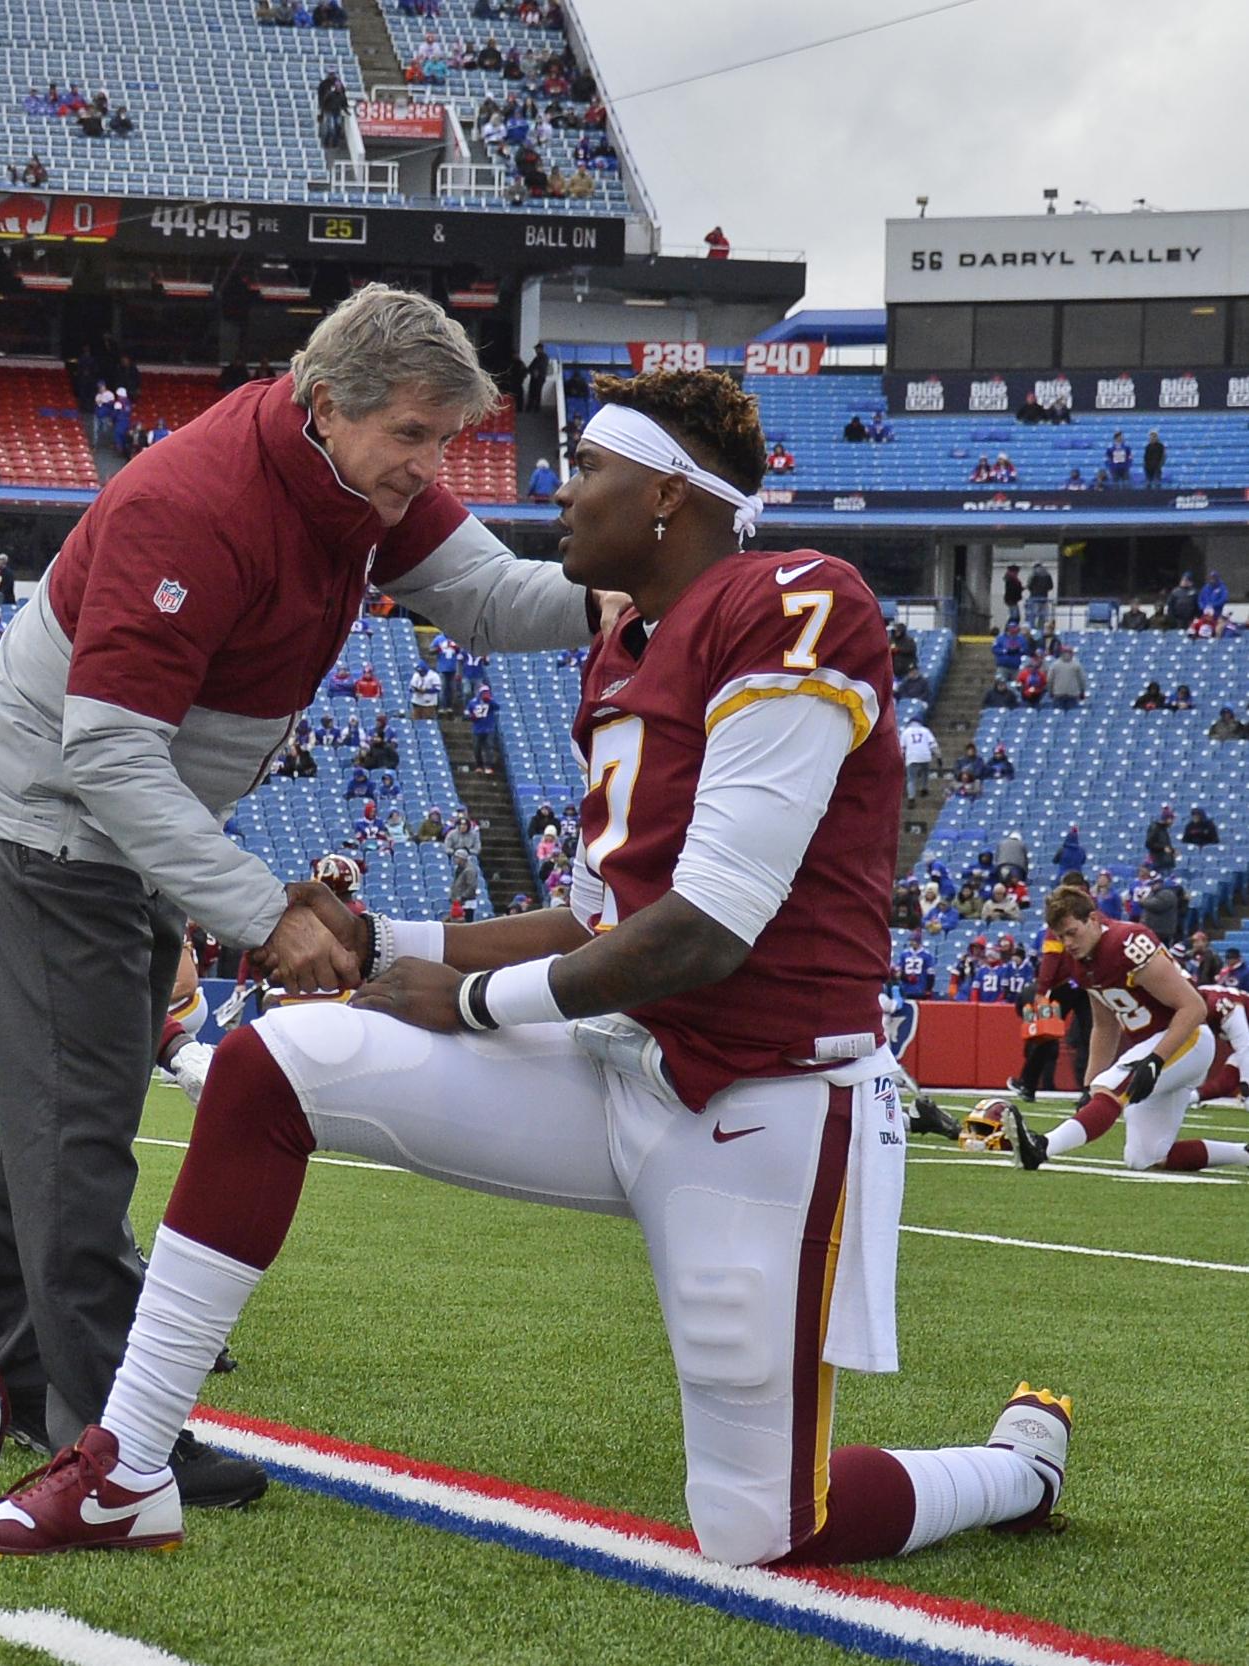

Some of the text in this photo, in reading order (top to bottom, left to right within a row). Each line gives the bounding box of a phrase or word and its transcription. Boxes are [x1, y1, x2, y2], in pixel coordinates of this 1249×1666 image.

[73, 203, 93, 232] 0
[151, 206, 279, 240] 44:45 PRE
[325, 219, 352, 238] 25
[433, 223, 445, 242] &
[525, 225, 597, 248] BALL ON
[958, 252, 1075, 268] DARRYL
[1091, 248, 1202, 265] TALLEY
[642, 343, 705, 373] 239
[746, 343, 810, 375] 240
[907, 381, 943, 397] Blue
[971, 381, 1007, 397] Blue
[782, 588, 834, 669] 7
[588, 714, 645, 933] 7
[1123, 933, 1156, 965] 88
[905, 957, 924, 975] 23
[983, 974, 998, 991] 21
